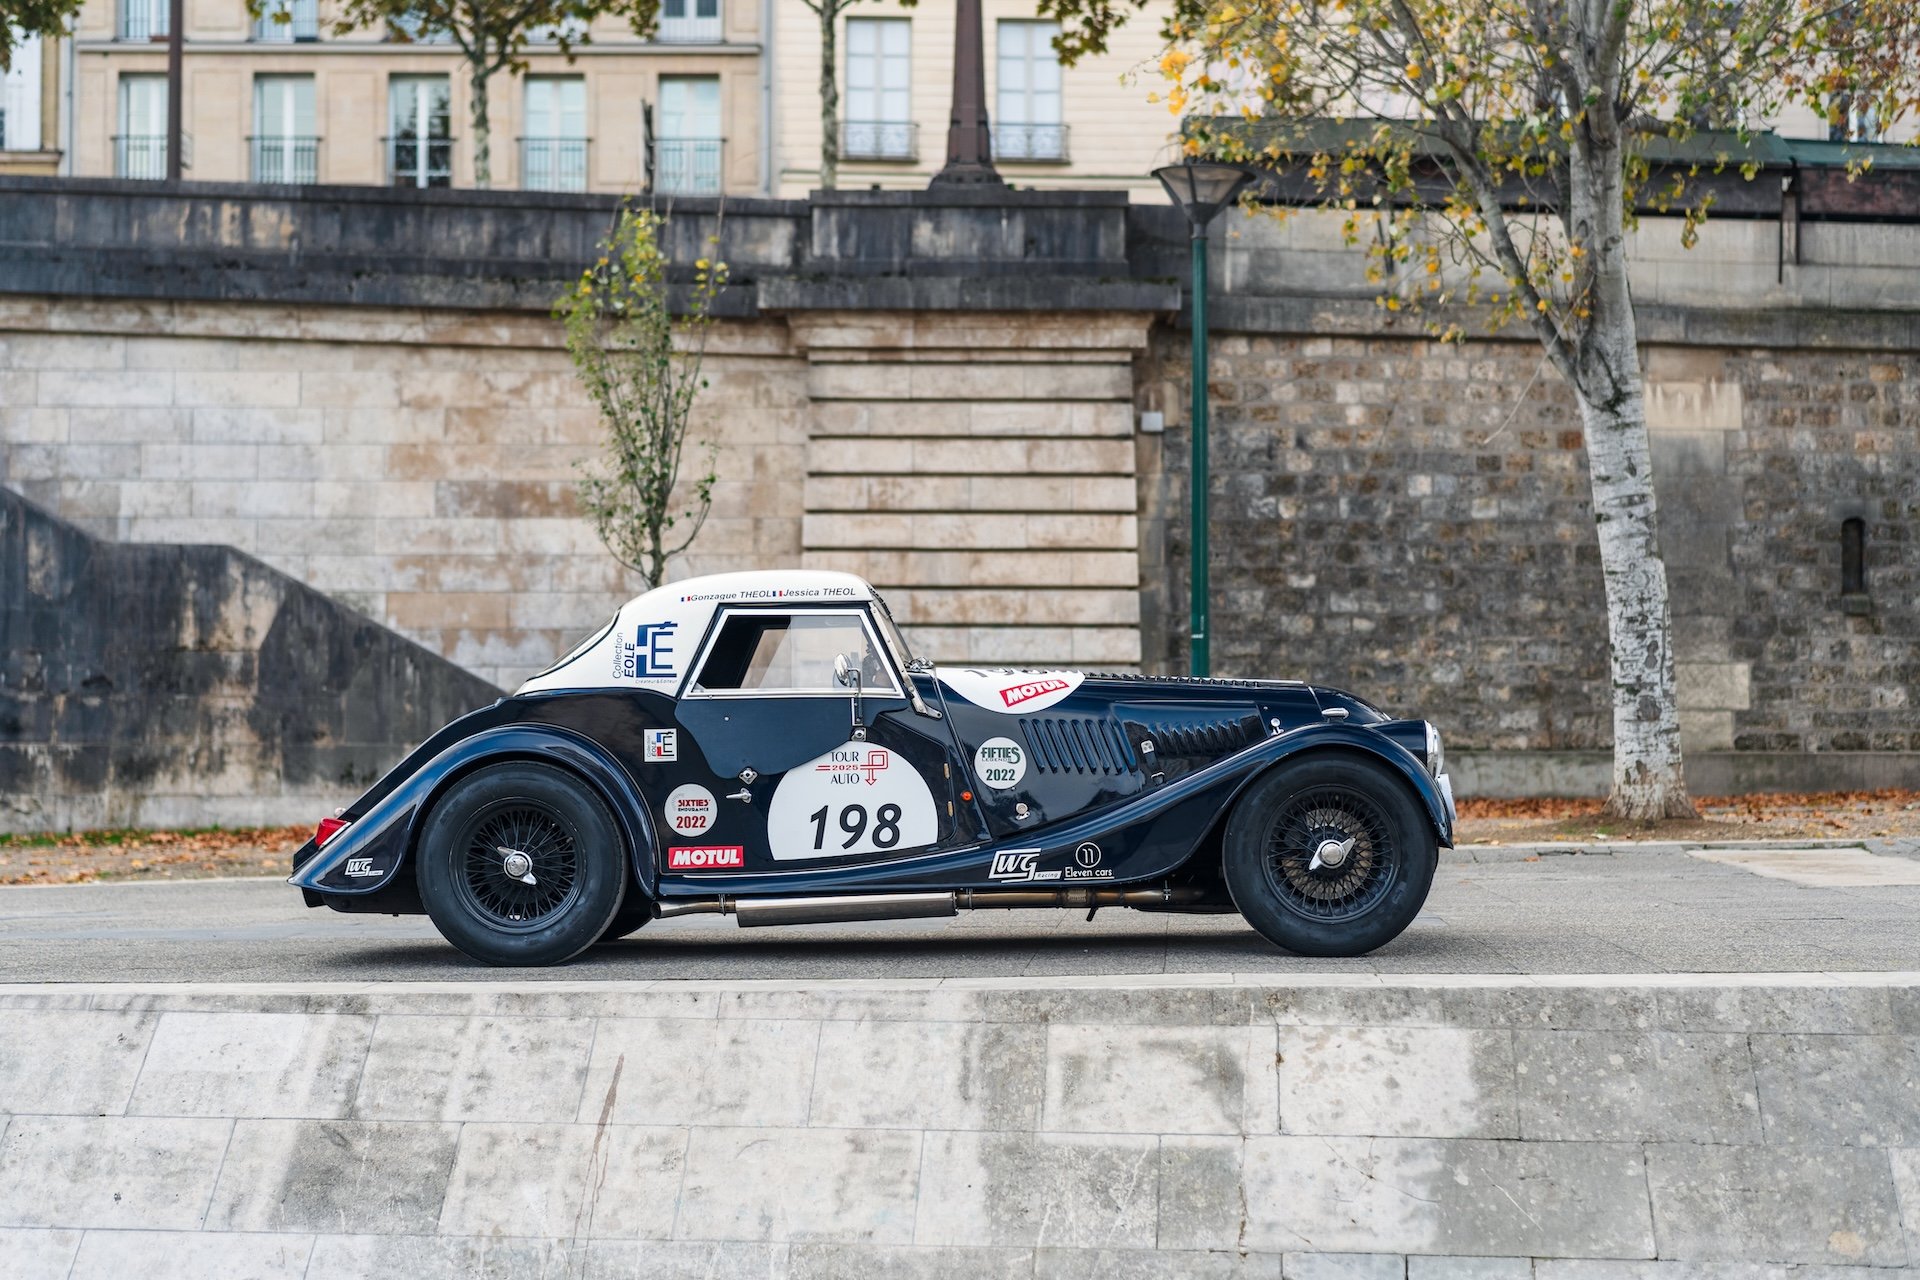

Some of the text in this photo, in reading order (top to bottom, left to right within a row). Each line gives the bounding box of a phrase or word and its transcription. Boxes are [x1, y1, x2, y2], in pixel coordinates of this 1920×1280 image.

[691, 590, 772, 602] Gonzague THEOL
[783, 587, 856, 597] Jessica THEOL
[612, 632, 624, 679] Collection
[1005, 680, 1065, 704] MOTUL
[831, 751, 859, 762] TOUR
[981, 747, 1020, 764] FIFTIES
[830, 773, 860, 785] AUTO
[986, 768, 1015, 781] 2022
[676, 815, 706, 829] 2022
[810, 803, 902, 850] 198
[672, 849, 740, 865] MOTUL
[348, 860, 373, 876] WG
[994, 850, 1040, 883] WG
[1064, 867, 1113, 878] Eleven cars
